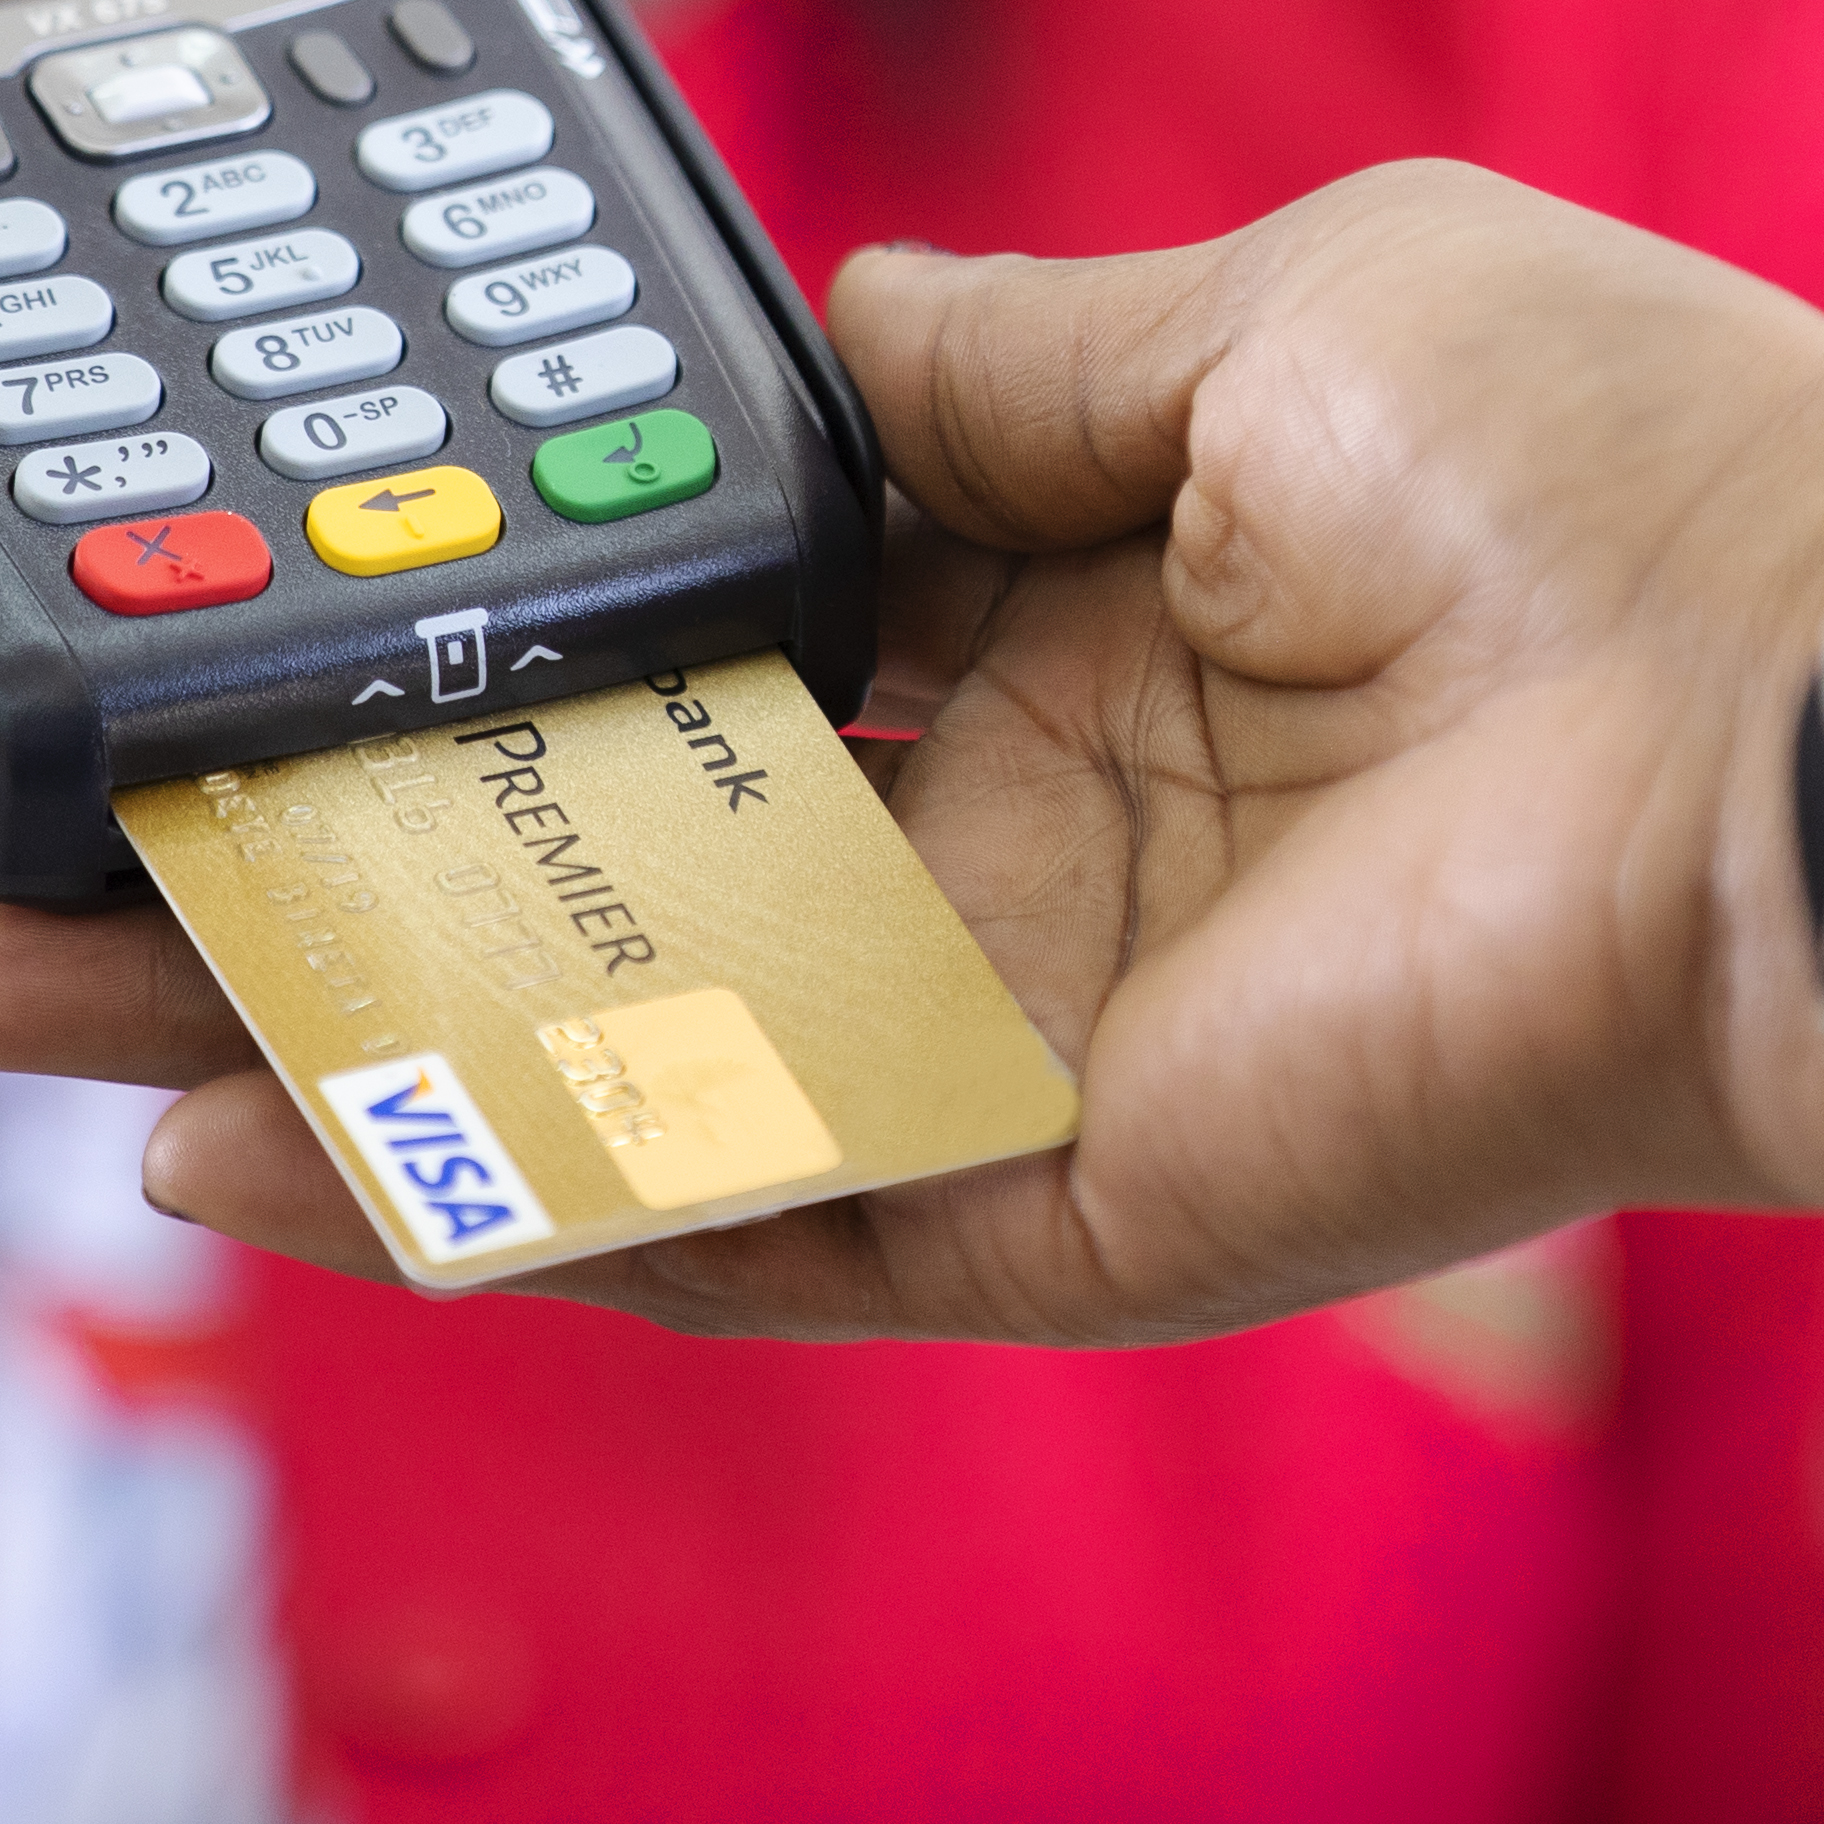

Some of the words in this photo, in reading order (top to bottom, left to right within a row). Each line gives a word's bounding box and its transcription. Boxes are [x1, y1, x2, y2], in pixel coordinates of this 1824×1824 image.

[401, 126, 447, 163] 3
[436, 107, 492, 138] DEF
[160, 170, 209, 217] 2
[202, 163, 266, 193] ABC
[442, 203, 488, 249] 6
[477, 182, 548, 215] MNO
[210, 257, 254, 294] 5
[249, 245, 308, 271] JKL
[484, 281, 529, 317] 9
[519, 258, 583, 291] WXY
[254, 334, 301, 372] 8
[291, 317, 354, 347] TUV
[1, 376, 38, 415] 7
[44, 365, 110, 392] PRS
[537, 354, 584, 398] #
[303, 412, 347, 451] 0
[453, 720, 657, 978] PREMIER
[367, 1067, 516, 1248] VISA
